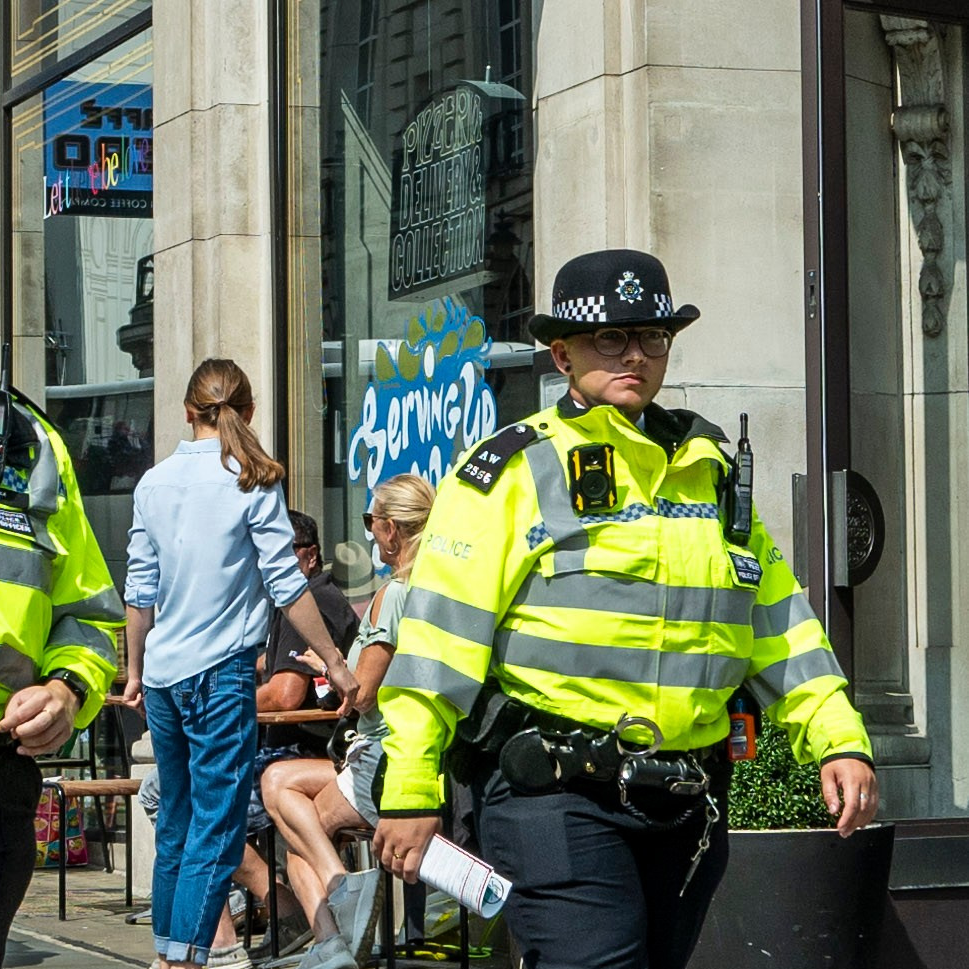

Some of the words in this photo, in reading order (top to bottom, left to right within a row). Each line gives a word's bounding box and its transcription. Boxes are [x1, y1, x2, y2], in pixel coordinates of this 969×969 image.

[43, 172, 64, 219] Let
[101, 143, 119, 190] be
[399, 149, 471, 230] DELIVERY
[469, 145, 482, 204] &
[391, 203, 486, 292] COLLECTION
[464, 462, 493, 484] 2556
[477, 450, 502, 464] AW
